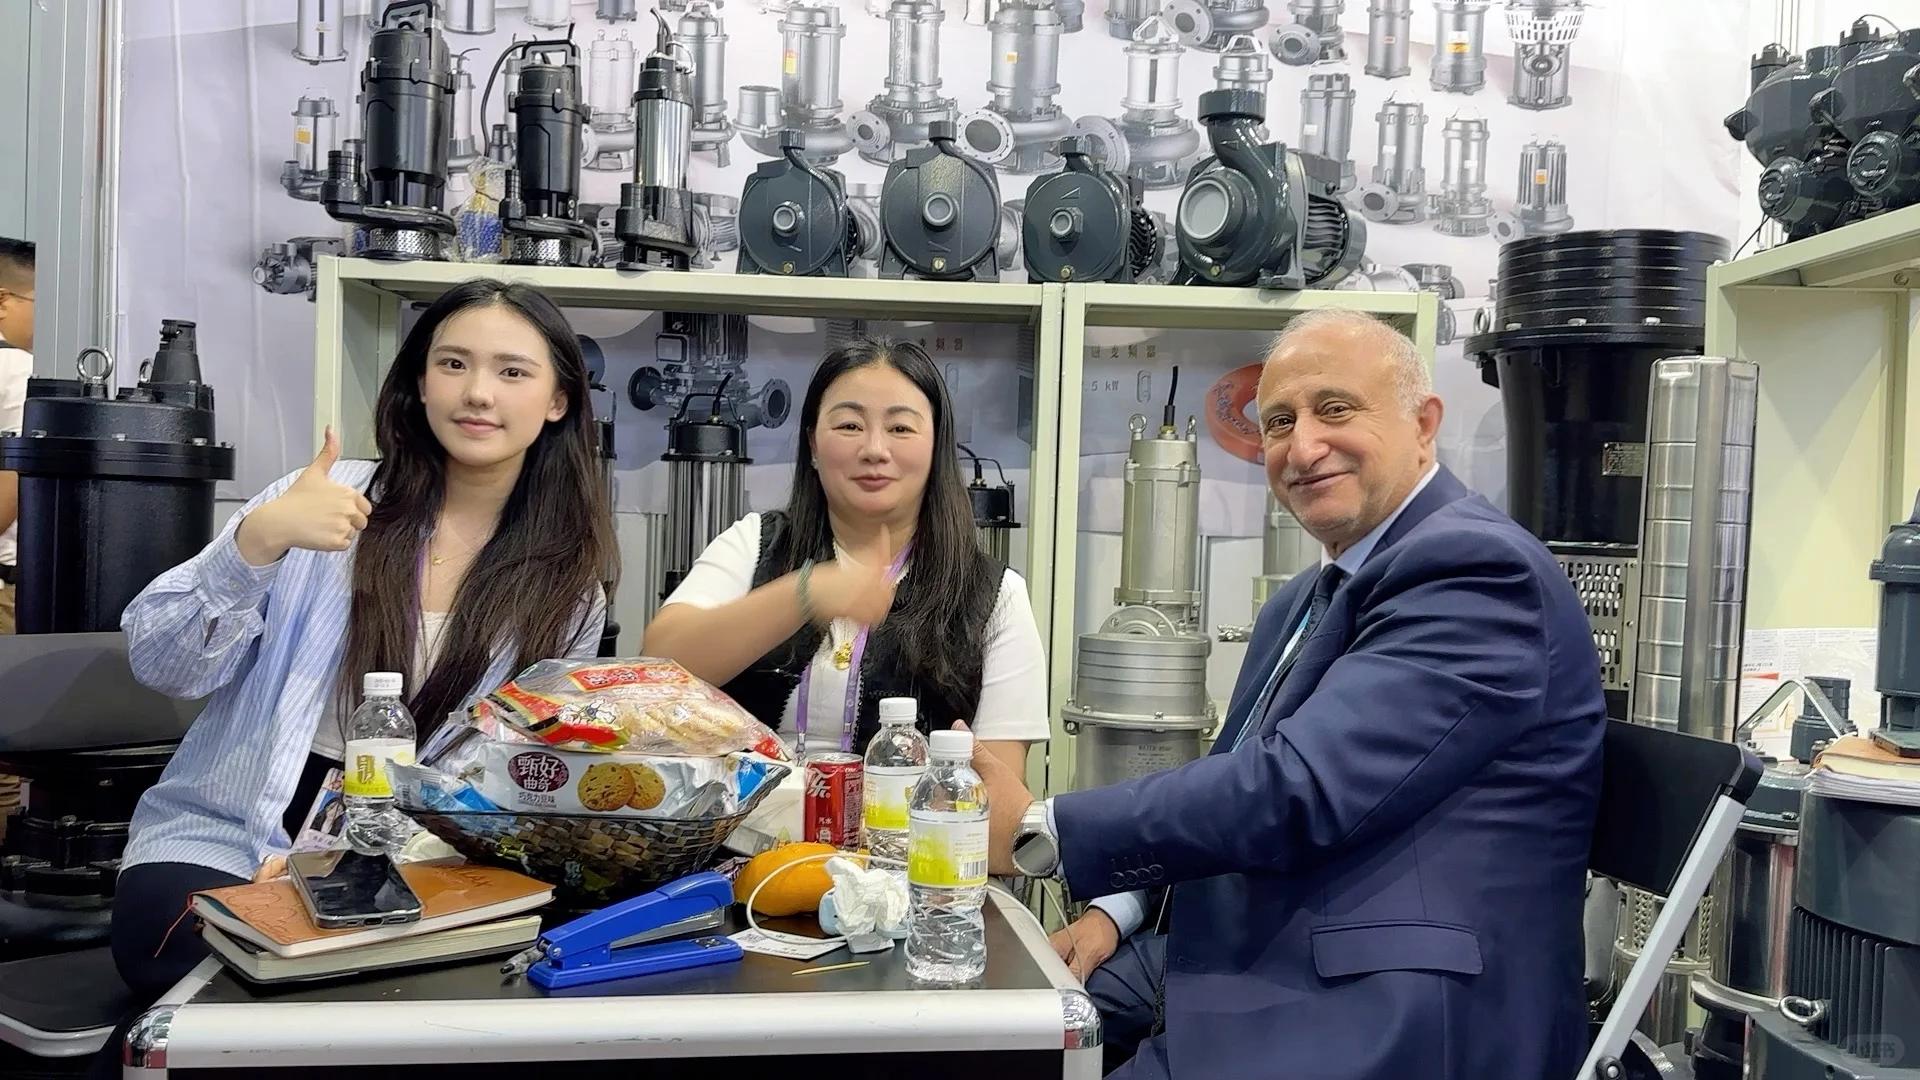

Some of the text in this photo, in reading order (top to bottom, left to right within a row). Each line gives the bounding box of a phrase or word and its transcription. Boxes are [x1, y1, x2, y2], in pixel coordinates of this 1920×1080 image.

[1105, 380, 1119, 392] kW
[517, 754, 560, 778] 甄好
[523, 777, 552, 793] 曲奇
[818, 816, 833, 825] 汽水
